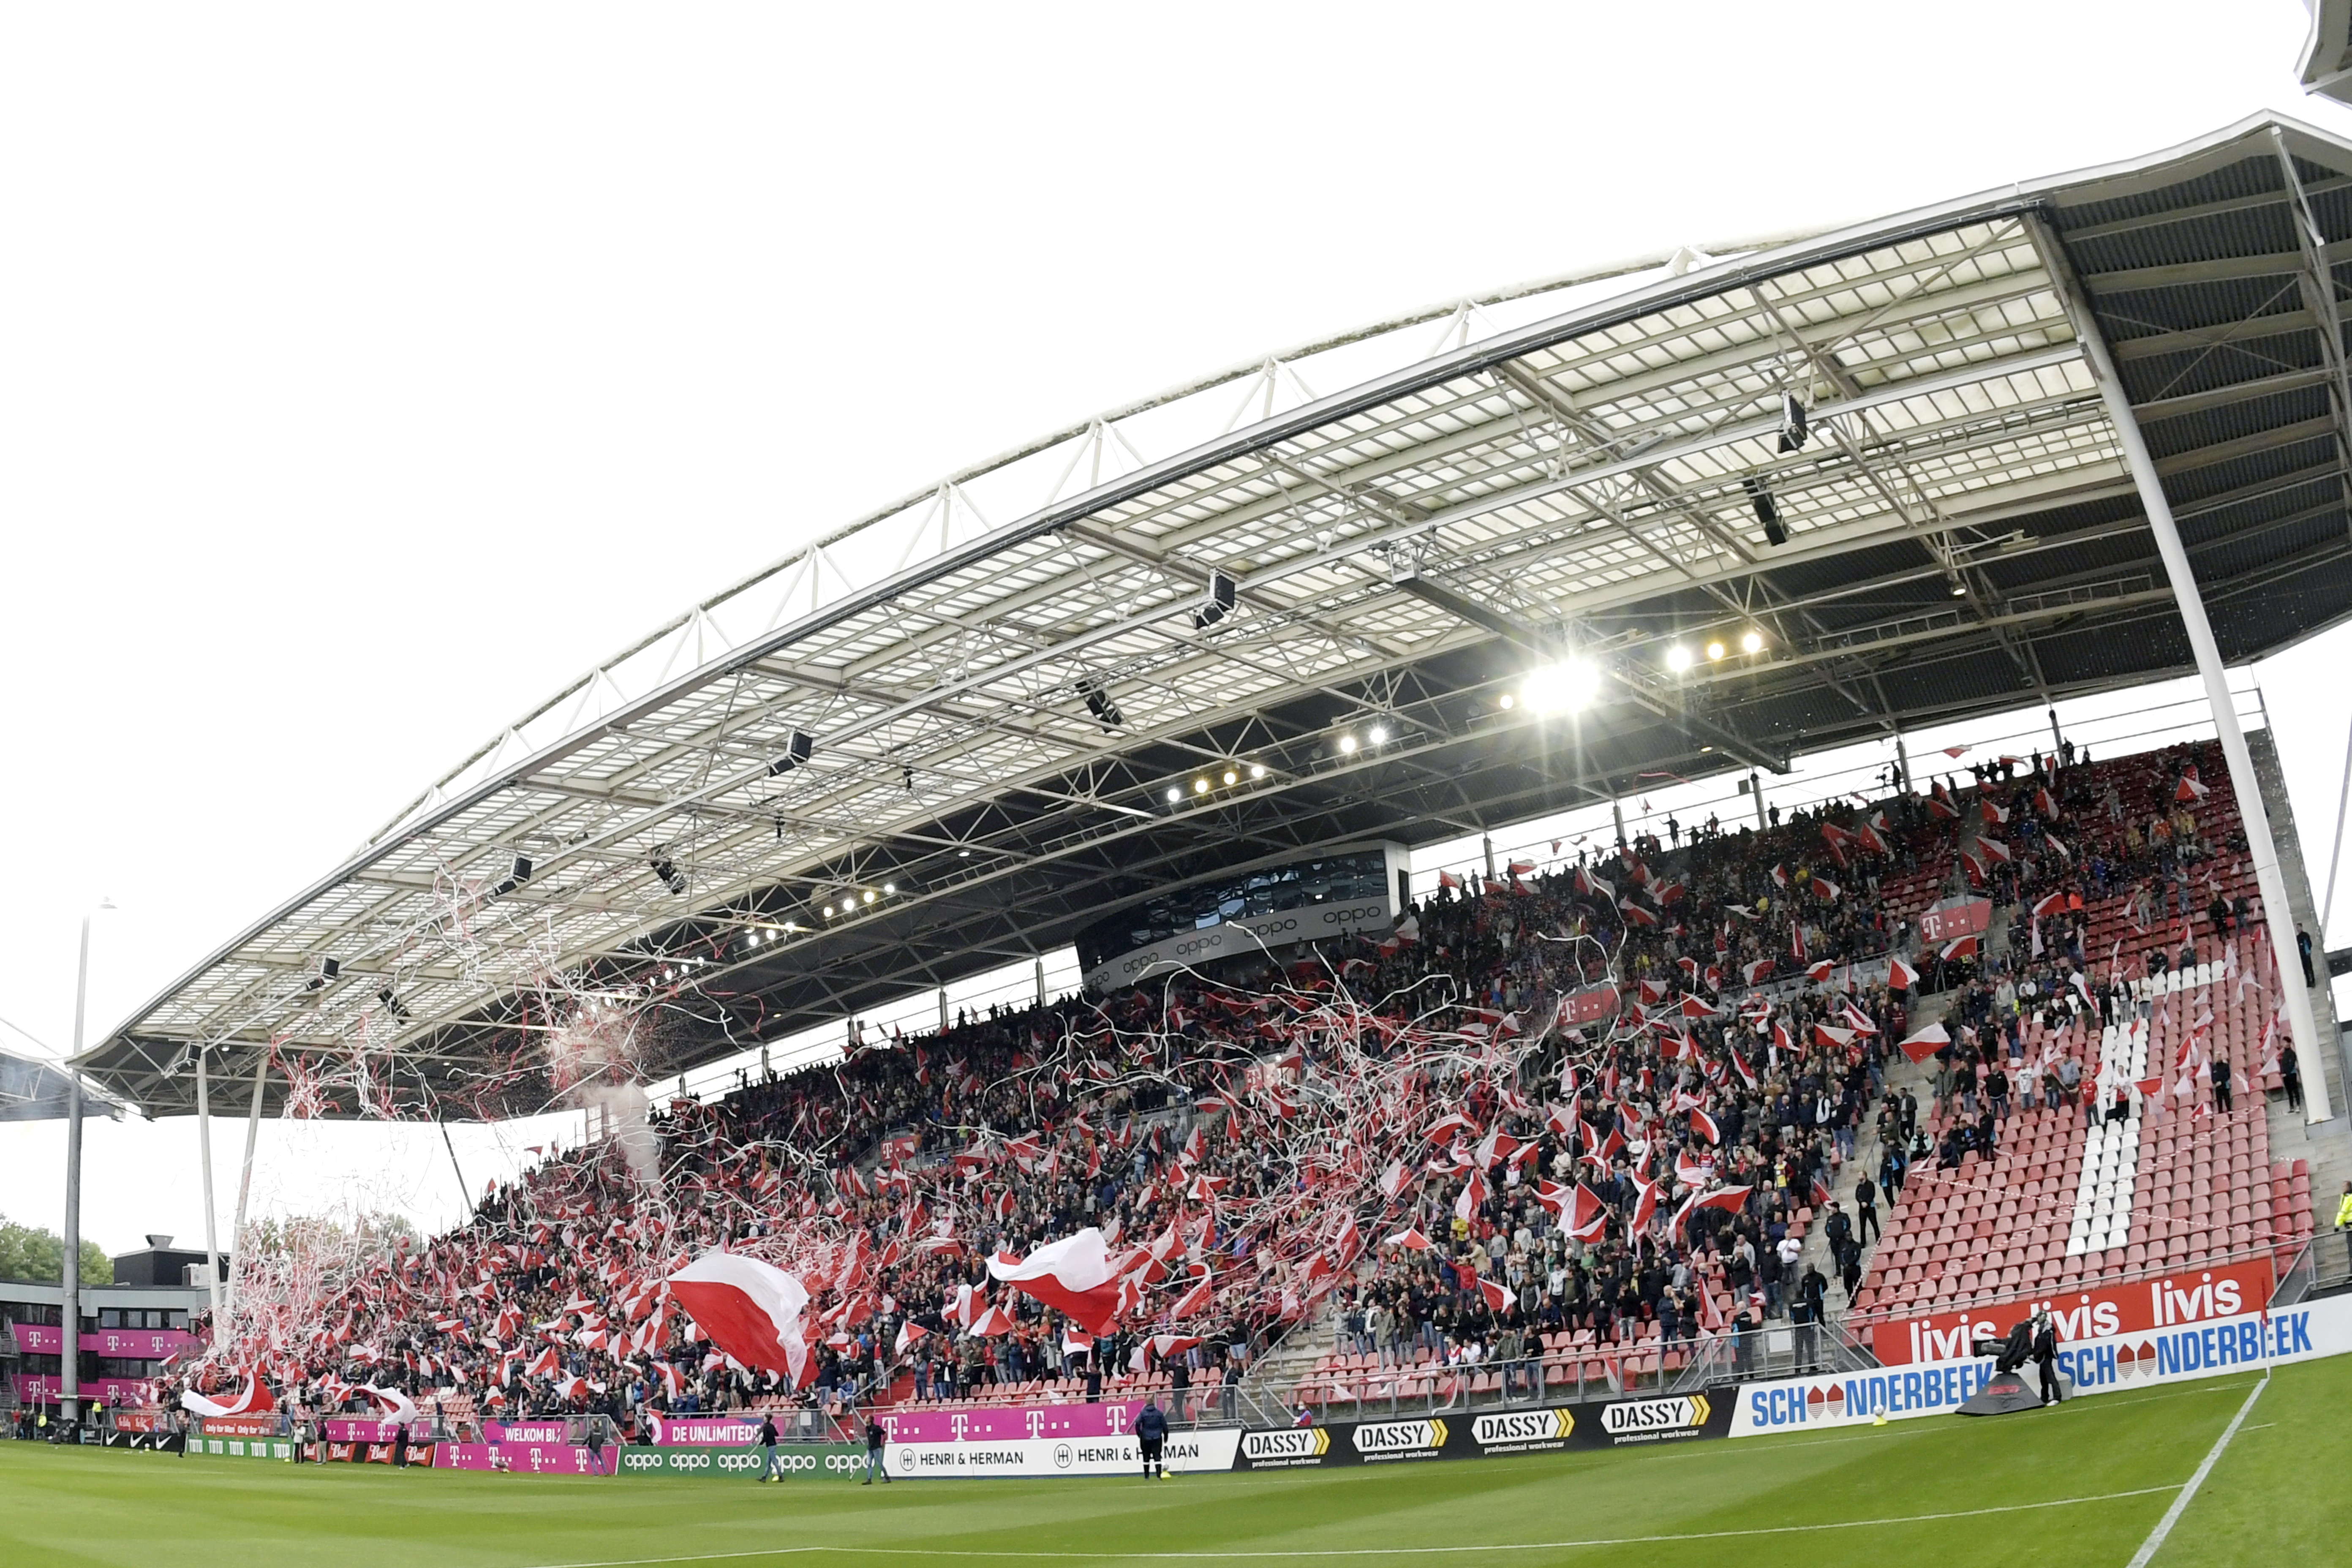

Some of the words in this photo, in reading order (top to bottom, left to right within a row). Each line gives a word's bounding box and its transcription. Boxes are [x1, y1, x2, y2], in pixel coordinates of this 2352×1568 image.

[1323, 906, 1380, 925] oppo
[1244, 919, 1297, 938] oppo
[1176, 935, 1222, 955] oppo
[1123, 953, 1159, 973] oppo
[2151, 1272, 2242, 1326] livis
[1612, 1401, 1684, 1429] DASSY
[505, 1427, 544, 1442] WELKOM
[672, 1425, 687, 1442] DE
[1481, 1414, 1549, 1440] DASSY
[1250, 1433, 1308, 1454] DASSY
[1362, 1424, 1425, 1448] DASSY
[1614, 1432, 1659, 1444] professional
[1661, 1429, 1699, 1439] workwear
[189, 1439, 203, 1453] TOTO
[208, 1440, 223, 1455] TOTO
[229, 1441, 244, 1456] TOTO
[250, 1442, 267, 1457] TOTO
[273, 1443, 290, 1459] TOTO
[331, 1443, 350, 1458] Bud
[369, 1445, 389, 1459] Bud
[406, 1446, 427, 1461] Bud
[1078, 1448, 1118, 1462] HENRI
[1123, 1448, 1132, 1460] &
[1136, 1444, 1199, 1459] HMAN
[1484, 1443, 1527, 1455] professional
[1528, 1440, 1565, 1450] workwear
[625, 1454, 663, 1471] oppo
[670, 1454, 710, 1471] oppo
[718, 1454, 761, 1472] oppo
[825, 1454, 875, 1473] oppo
[920, 1452, 954, 1465] HENRI
[958, 1452, 965, 1465] &
[969, 1451, 1023, 1465] HERMAN
[1252, 1459, 1289, 1469] professional
[1290, 1457, 1321, 1465] workwear
[1364, 1451, 1404, 1462] professional
[1405, 1450, 1439, 1459] workwear
